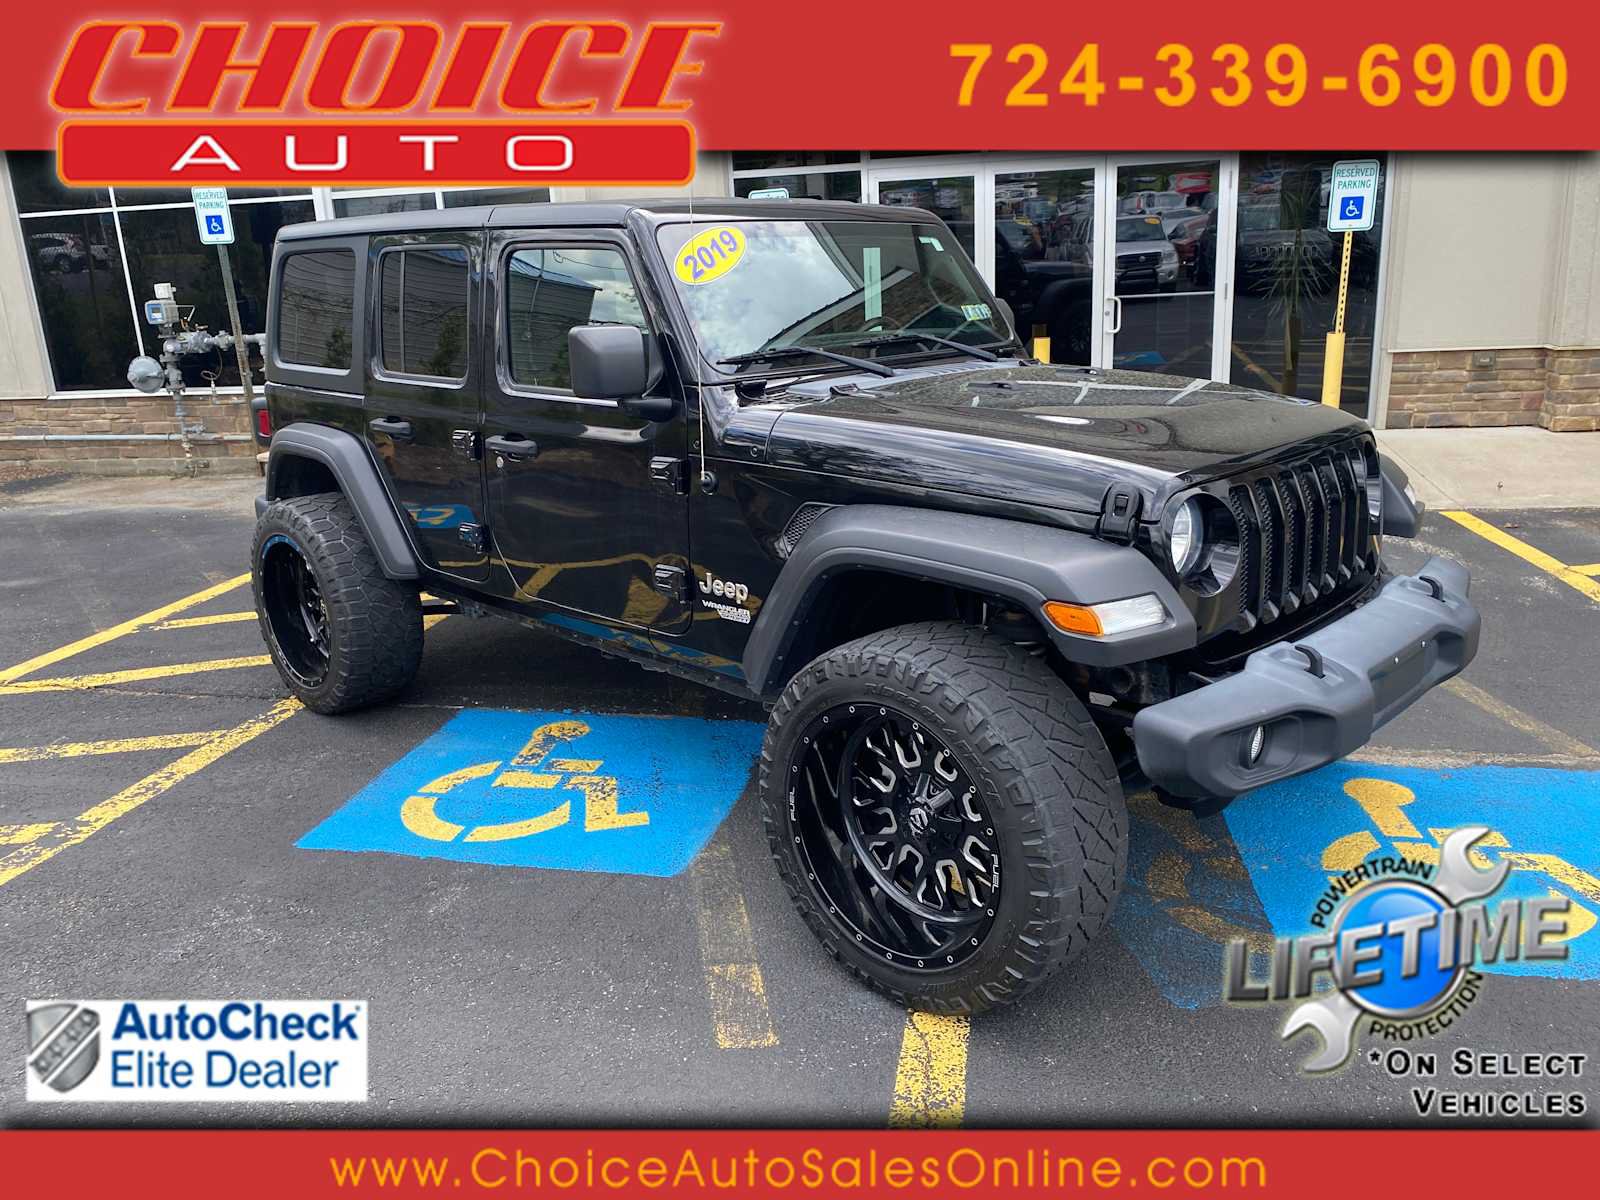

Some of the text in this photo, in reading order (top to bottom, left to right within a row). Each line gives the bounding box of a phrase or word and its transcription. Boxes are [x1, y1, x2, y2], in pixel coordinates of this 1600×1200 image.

[1336, 168, 1375, 177] RESERVED
[1337, 180, 1371, 189] PARKING
[199, 201, 225, 209] PARKING
[683, 230, 737, 280] 2019
[699, 572, 748, 604] Jeep
[991, 853, 1000, 894] FUEL
